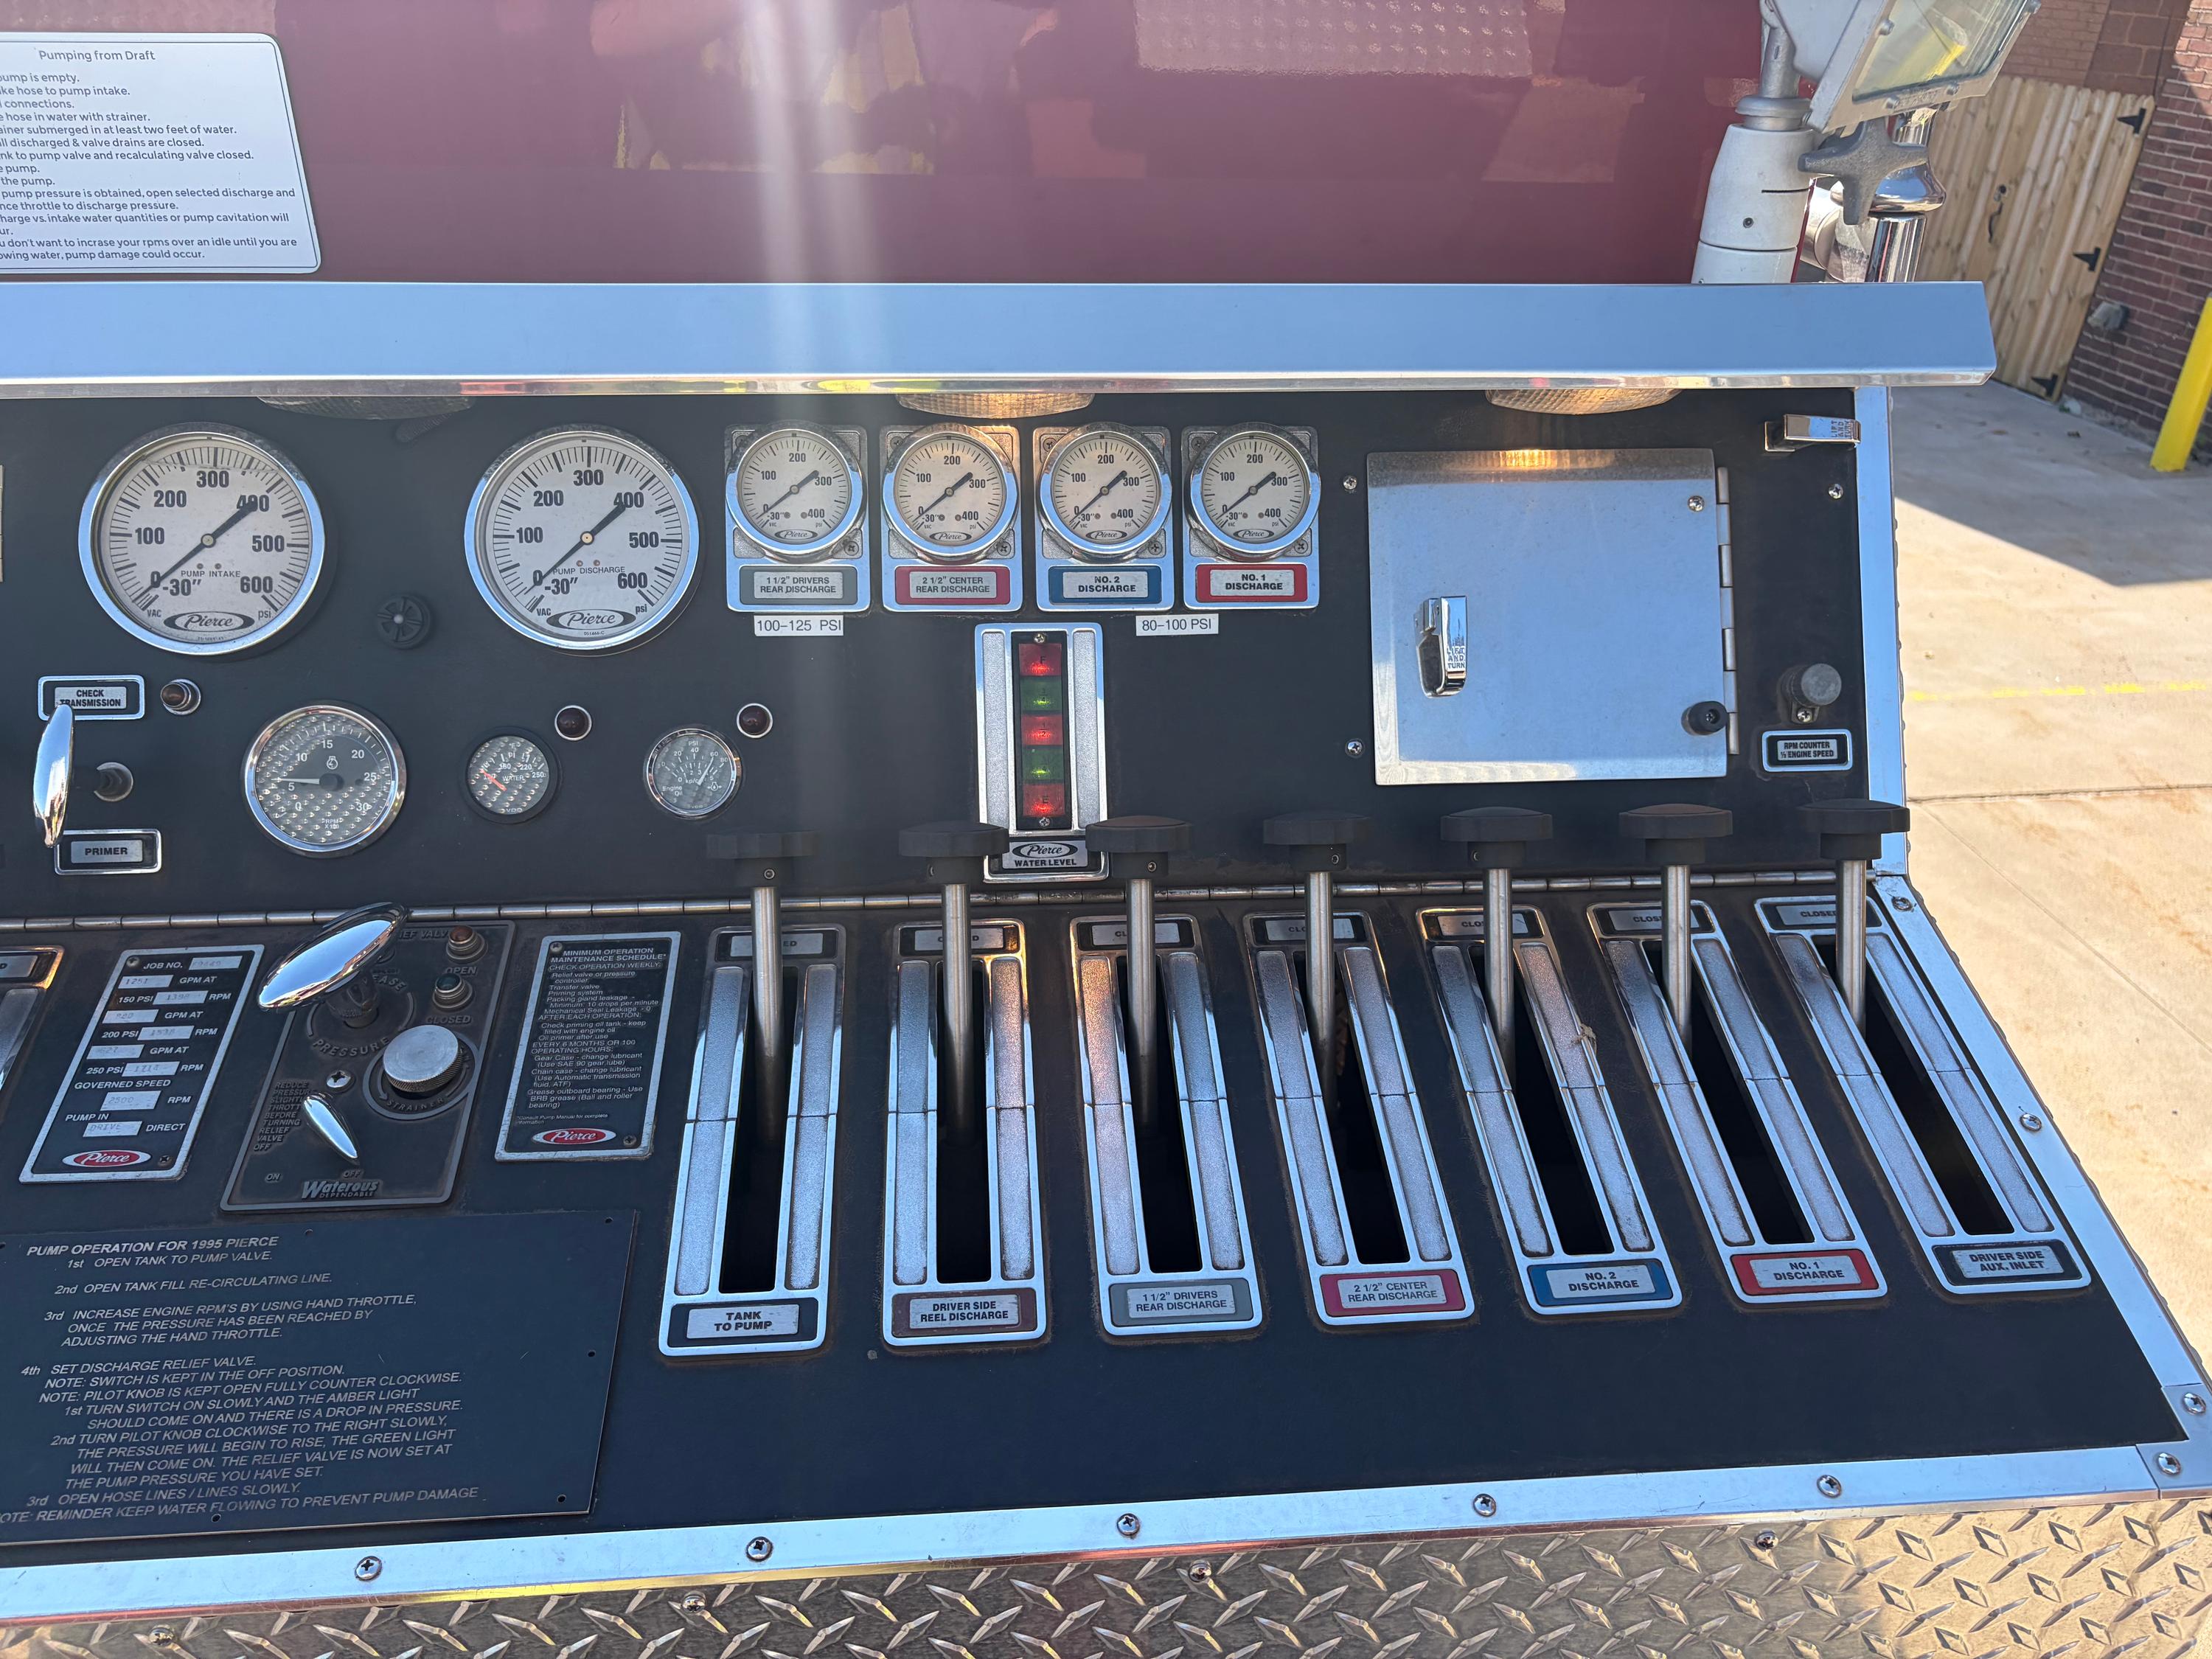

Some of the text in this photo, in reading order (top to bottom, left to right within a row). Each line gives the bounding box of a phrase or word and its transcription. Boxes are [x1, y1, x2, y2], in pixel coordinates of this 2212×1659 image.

[39, 50, 155, 62] Pumping from Draft
[6, 112, 150, 122] hose in water with strainer.
[15, 150, 254, 162] to pump valve and recalculating valve closed.
[2, 188, 295, 200] pump pressure is obtained, open selected discharge and
[789, 453, 806, 462] 200
[944, 456, 960, 465] 200
[1097, 454, 1114, 464] 200
[1247, 454, 1263, 464] 200
[196, 471, 229, 487] 300
[573, 470, 603, 486] 300
[762, 471, 776, 480] 100
[917, 473, 931, 482] 100
[1071, 473, 1085, 482] 100
[1220, 473, 1234, 481] 100
[970, 479, 985, 488] 300
[154, 491, 187, 507] 200
[533, 490, 563, 506] 200
[808, 509, 824, 518] 400
[962, 511, 978, 520] 400
[1117, 509, 1133, 518] 400
[1265, 509, 1281, 518] 400
[136, 527, 164, 544] 100
[517, 527, 543, 543] 100
[629, 532, 658, 548] 500
[252, 535, 285, 552] 500
[240, 577, 273, 593] 600
[618, 573, 647, 588] 600
[942, 585, 990, 593] DISCHARGE
[258, 609, 271, 619] psi
[537, 608, 551, 616] VAC
[636, 604, 647, 614] psi
[184, 613, 233, 627] Pierce
[567, 612, 615, 626] Pierce
[820, 620, 841, 630] PSI
[1191, 619, 1211, 630] PSI
[321, 740, 333, 748] 15
[296, 754, 307, 762] 10
[352, 750, 364, 758] 20
[364, 773, 377, 781] 25
[85, 847, 128, 855] PRIMER
[1027, 844, 1062, 855] Pierce
[74, 1081, 133, 1089] GOVERNED
[146, 1123, 186, 1131] DIRECT
[551, 1130, 596, 1141] Pierce
[83, 1152, 130, 1164] Pierce
[302, 1181, 378, 1199] Waterous
[27, 1237, 279, 1256] PUMP OPERATION FOR 1995 PIERCE
[67, 1251, 272, 1268] 1st OPEN TANK TO PUMP VALVE.
[1969, 1251, 2044, 1262] DRIVER SIDE
[1790, 1262, 1819, 1272] NO. 1
[1980, 1261, 2045, 1272] AUX. INLET
[1585, 1271, 1616, 1281] NO. 2
[1773, 1269, 1844, 1281] DISCHARGE
[1354, 1284, 1361, 1293] 2
[1386, 1281, 1427, 1291] CENTER
[1568, 1280, 1639, 1291] DISCHARGE
[1173, 1290, 1217, 1300] DRIVERS
[1348, 1290, 1438, 1303] REAR DISCHARGE
[933, 1301, 996, 1311] DRIVER SIDE
[1136, 1300, 1227, 1312] REAR DISCHARGE
[726, 1312, 761, 1321] TANK
[920, 1310, 1009, 1322] REEL DISCHARGE
[714, 1321, 772, 1331] TO PUMP
[21, 1356, 256, 1375] 4th SET DISCHARGE RELIEF VALVE.
